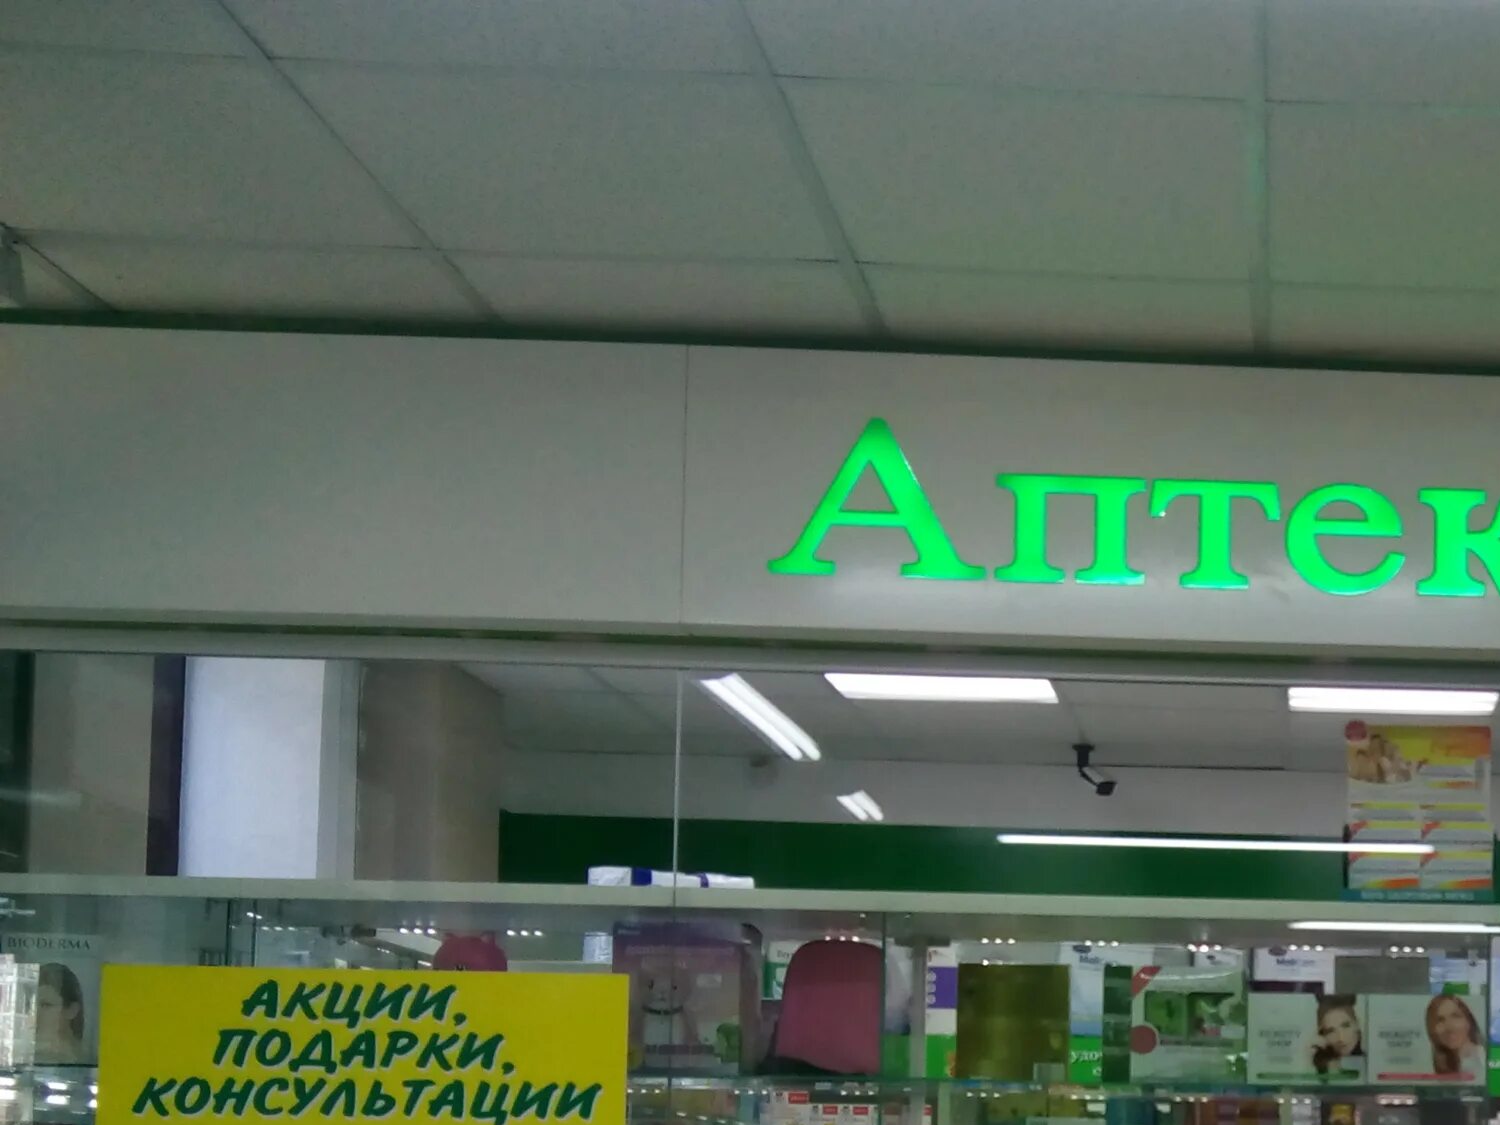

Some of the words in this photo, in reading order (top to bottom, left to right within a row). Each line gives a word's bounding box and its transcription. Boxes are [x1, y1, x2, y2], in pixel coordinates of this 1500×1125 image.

[8, 936, 91, 950] BIODERMA
[240, 979, 468, 1028] АКЦИИ,
[212, 1028, 515, 1074] ПОДАРКИ,
